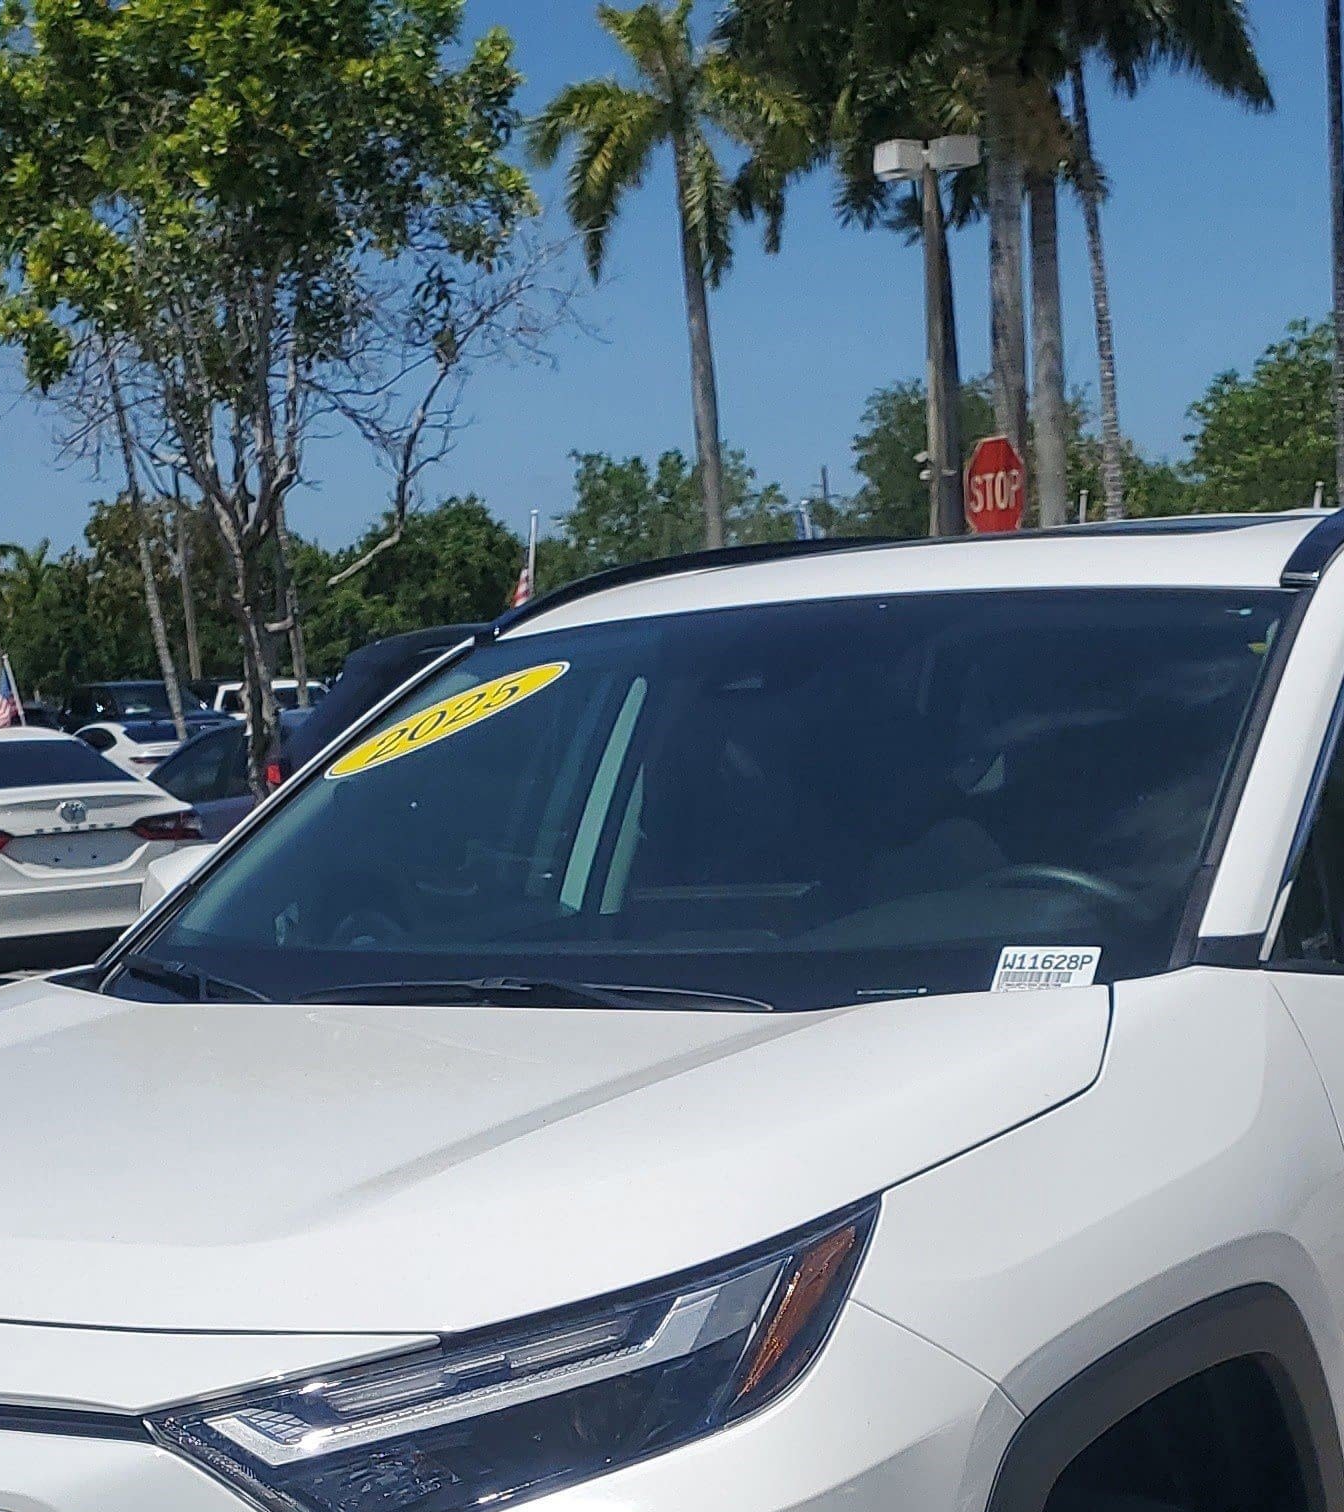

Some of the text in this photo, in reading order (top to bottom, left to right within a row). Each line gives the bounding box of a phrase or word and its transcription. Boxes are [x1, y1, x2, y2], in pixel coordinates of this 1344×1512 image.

[969, 468, 1022, 513] STOP
[364, 674, 529, 765] 2025
[1001, 953, 1094, 971] W11628P
